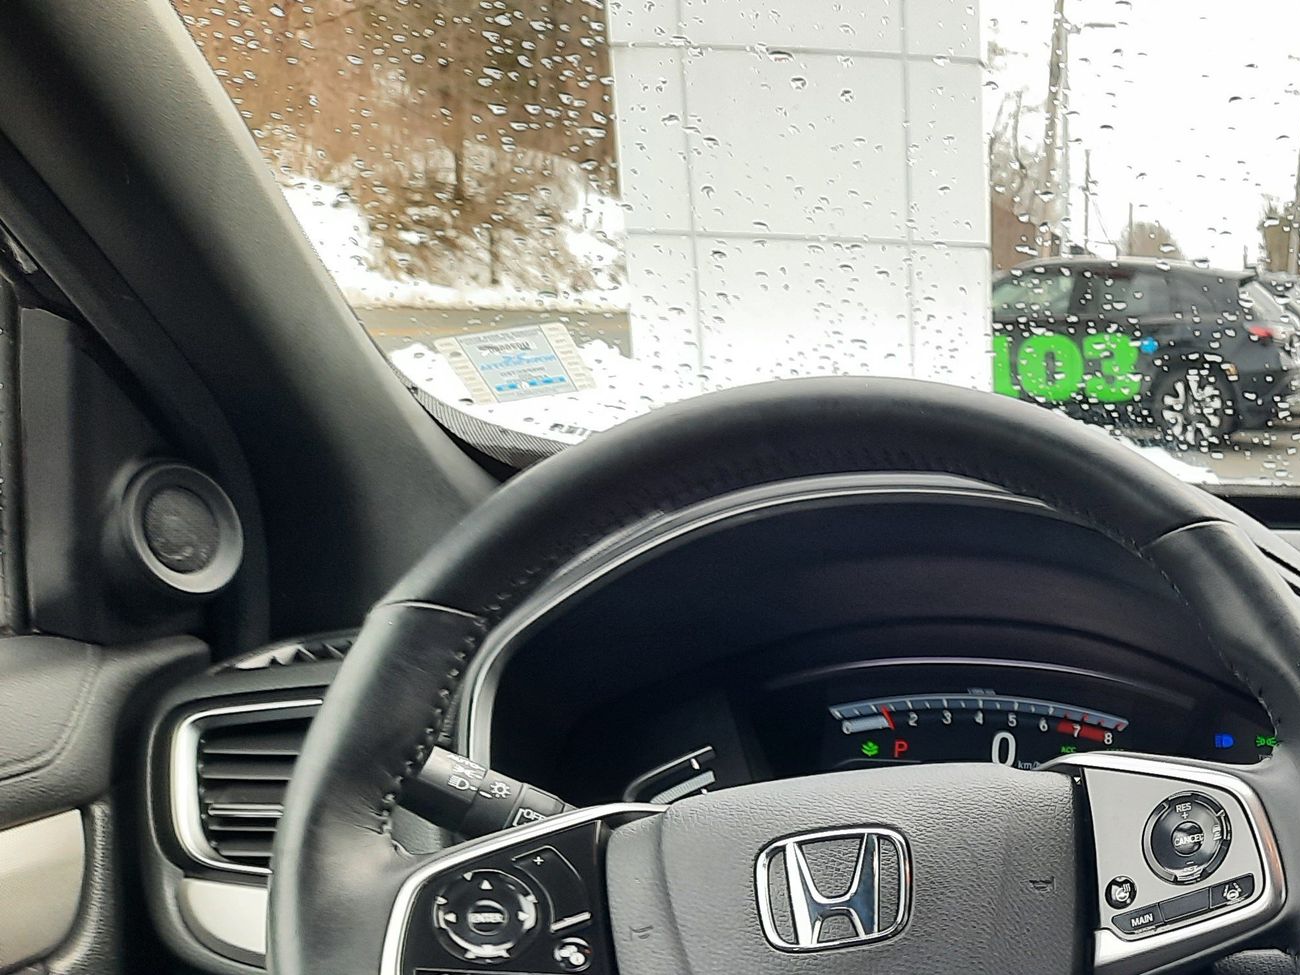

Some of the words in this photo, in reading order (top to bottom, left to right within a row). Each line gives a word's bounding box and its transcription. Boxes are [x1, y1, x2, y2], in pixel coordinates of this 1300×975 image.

[908, 711, 918, 727] 2
[942, 709, 952, 725] 3
[974, 710, 984, 725] 4
[1007, 712, 1017, 727] 5
[1039, 717, 1049, 732] 6
[1073, 723, 1082, 738] 7
[1104, 731, 1113, 745] 8
[894, 741, 909, 758] P
[991, 731, 1016, 767] 0
[1176, 802, 1192, 813] RES
[1131, 913, 1153, 927] MAIN
